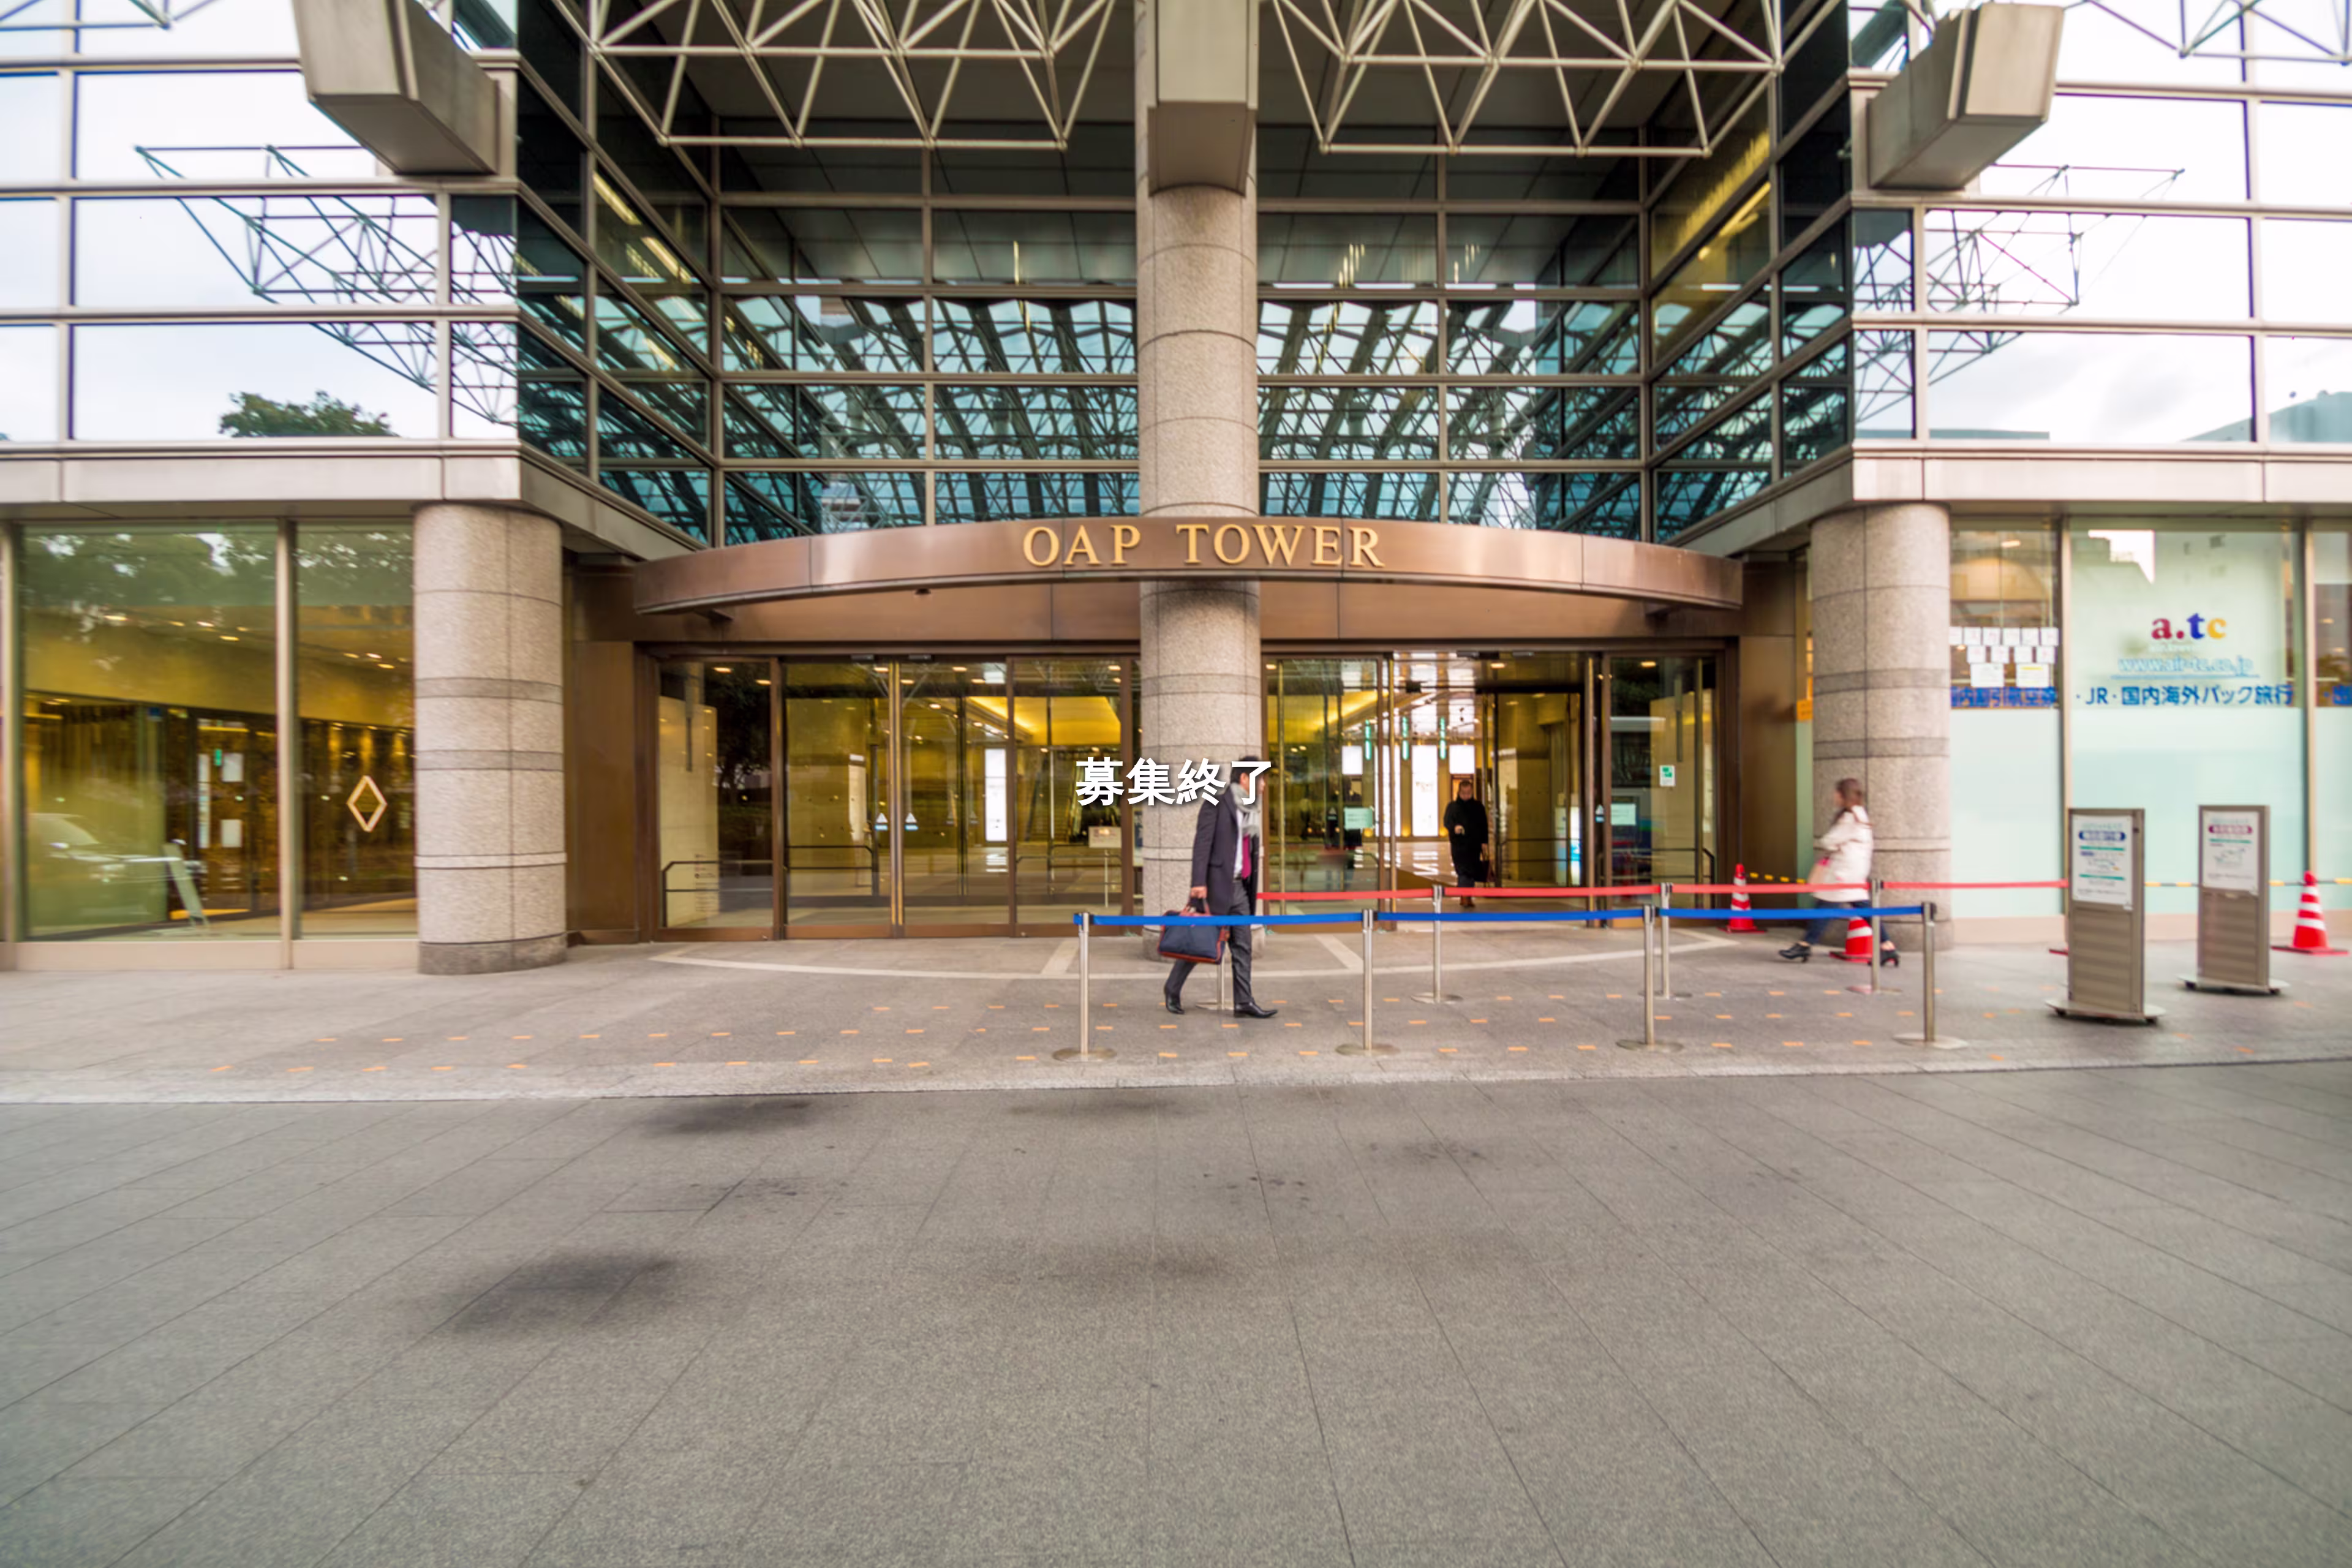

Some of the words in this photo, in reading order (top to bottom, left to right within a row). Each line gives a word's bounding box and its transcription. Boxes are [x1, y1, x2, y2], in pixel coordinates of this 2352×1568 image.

[1023, 524, 1142, 567] OAP
[1175, 524, 1385, 568] TOWER
[2151, 612, 2227, 640] a.tc
